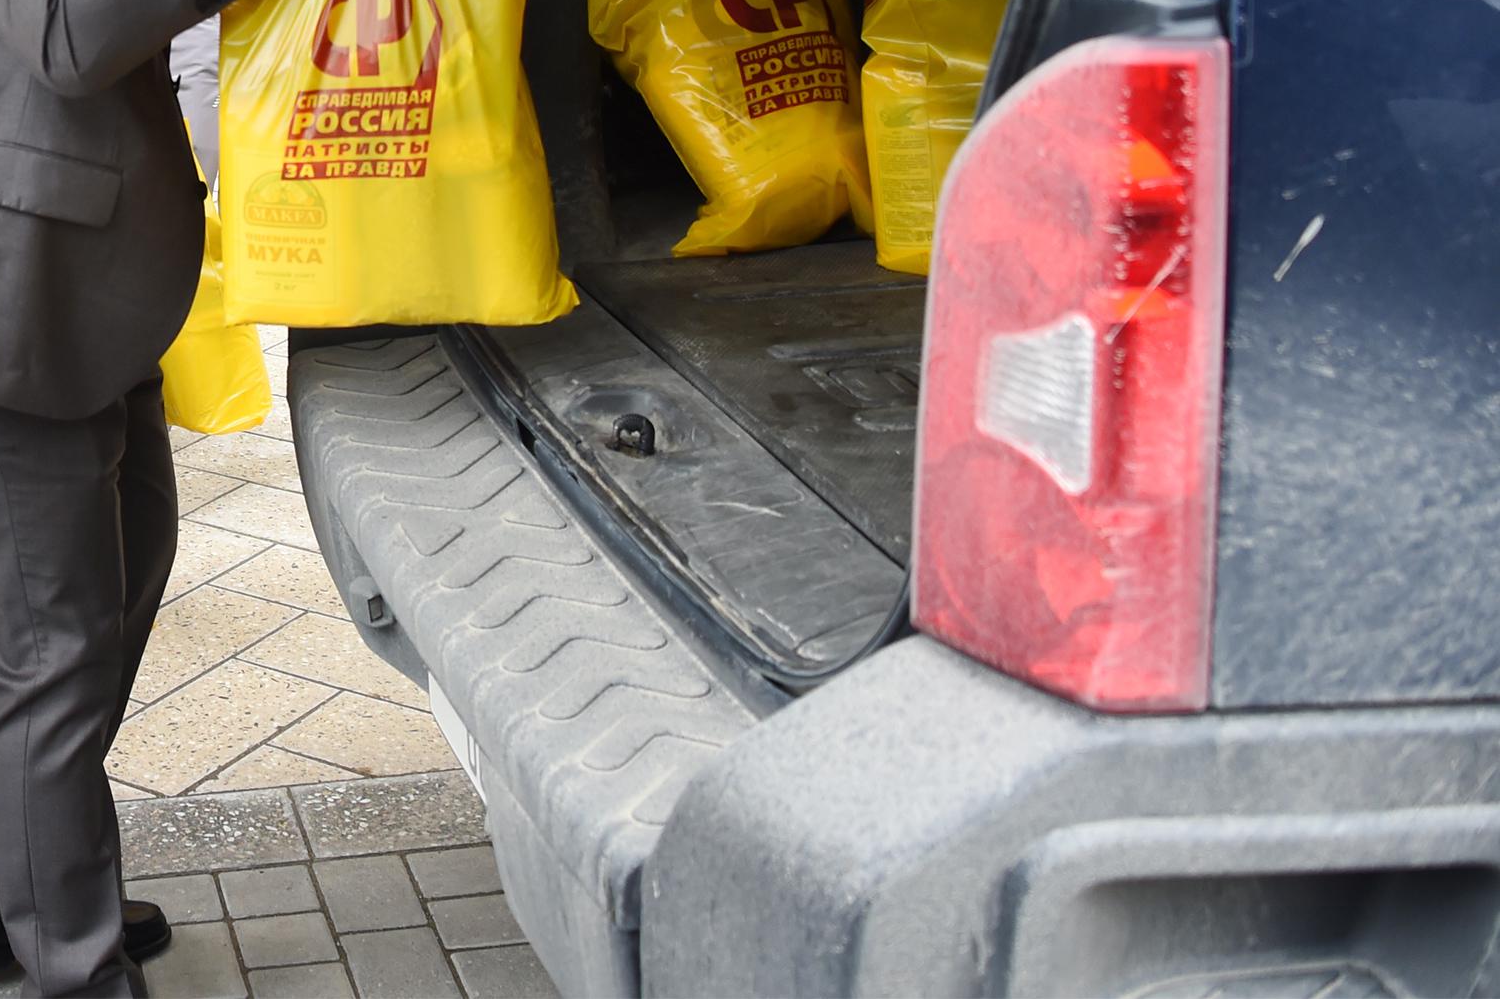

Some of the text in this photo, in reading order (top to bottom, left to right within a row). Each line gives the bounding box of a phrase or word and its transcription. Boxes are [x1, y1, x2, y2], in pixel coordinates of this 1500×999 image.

[740, 34, 840, 63] СПРАВЕДЛИВА
[743, 48, 844, 81] РОССИЯ
[296, 89, 432, 109] СПРАВЕДЛИВАЯ
[751, 88, 847, 116] ЗА ПРАВД
[291, 107, 430, 135] РОССИЯ
[285, 140, 429, 157] ПАТРИОТЫ
[284, 160, 423, 178] ЗА ПРАВДУ
[247, 243, 324, 264] МУКА
